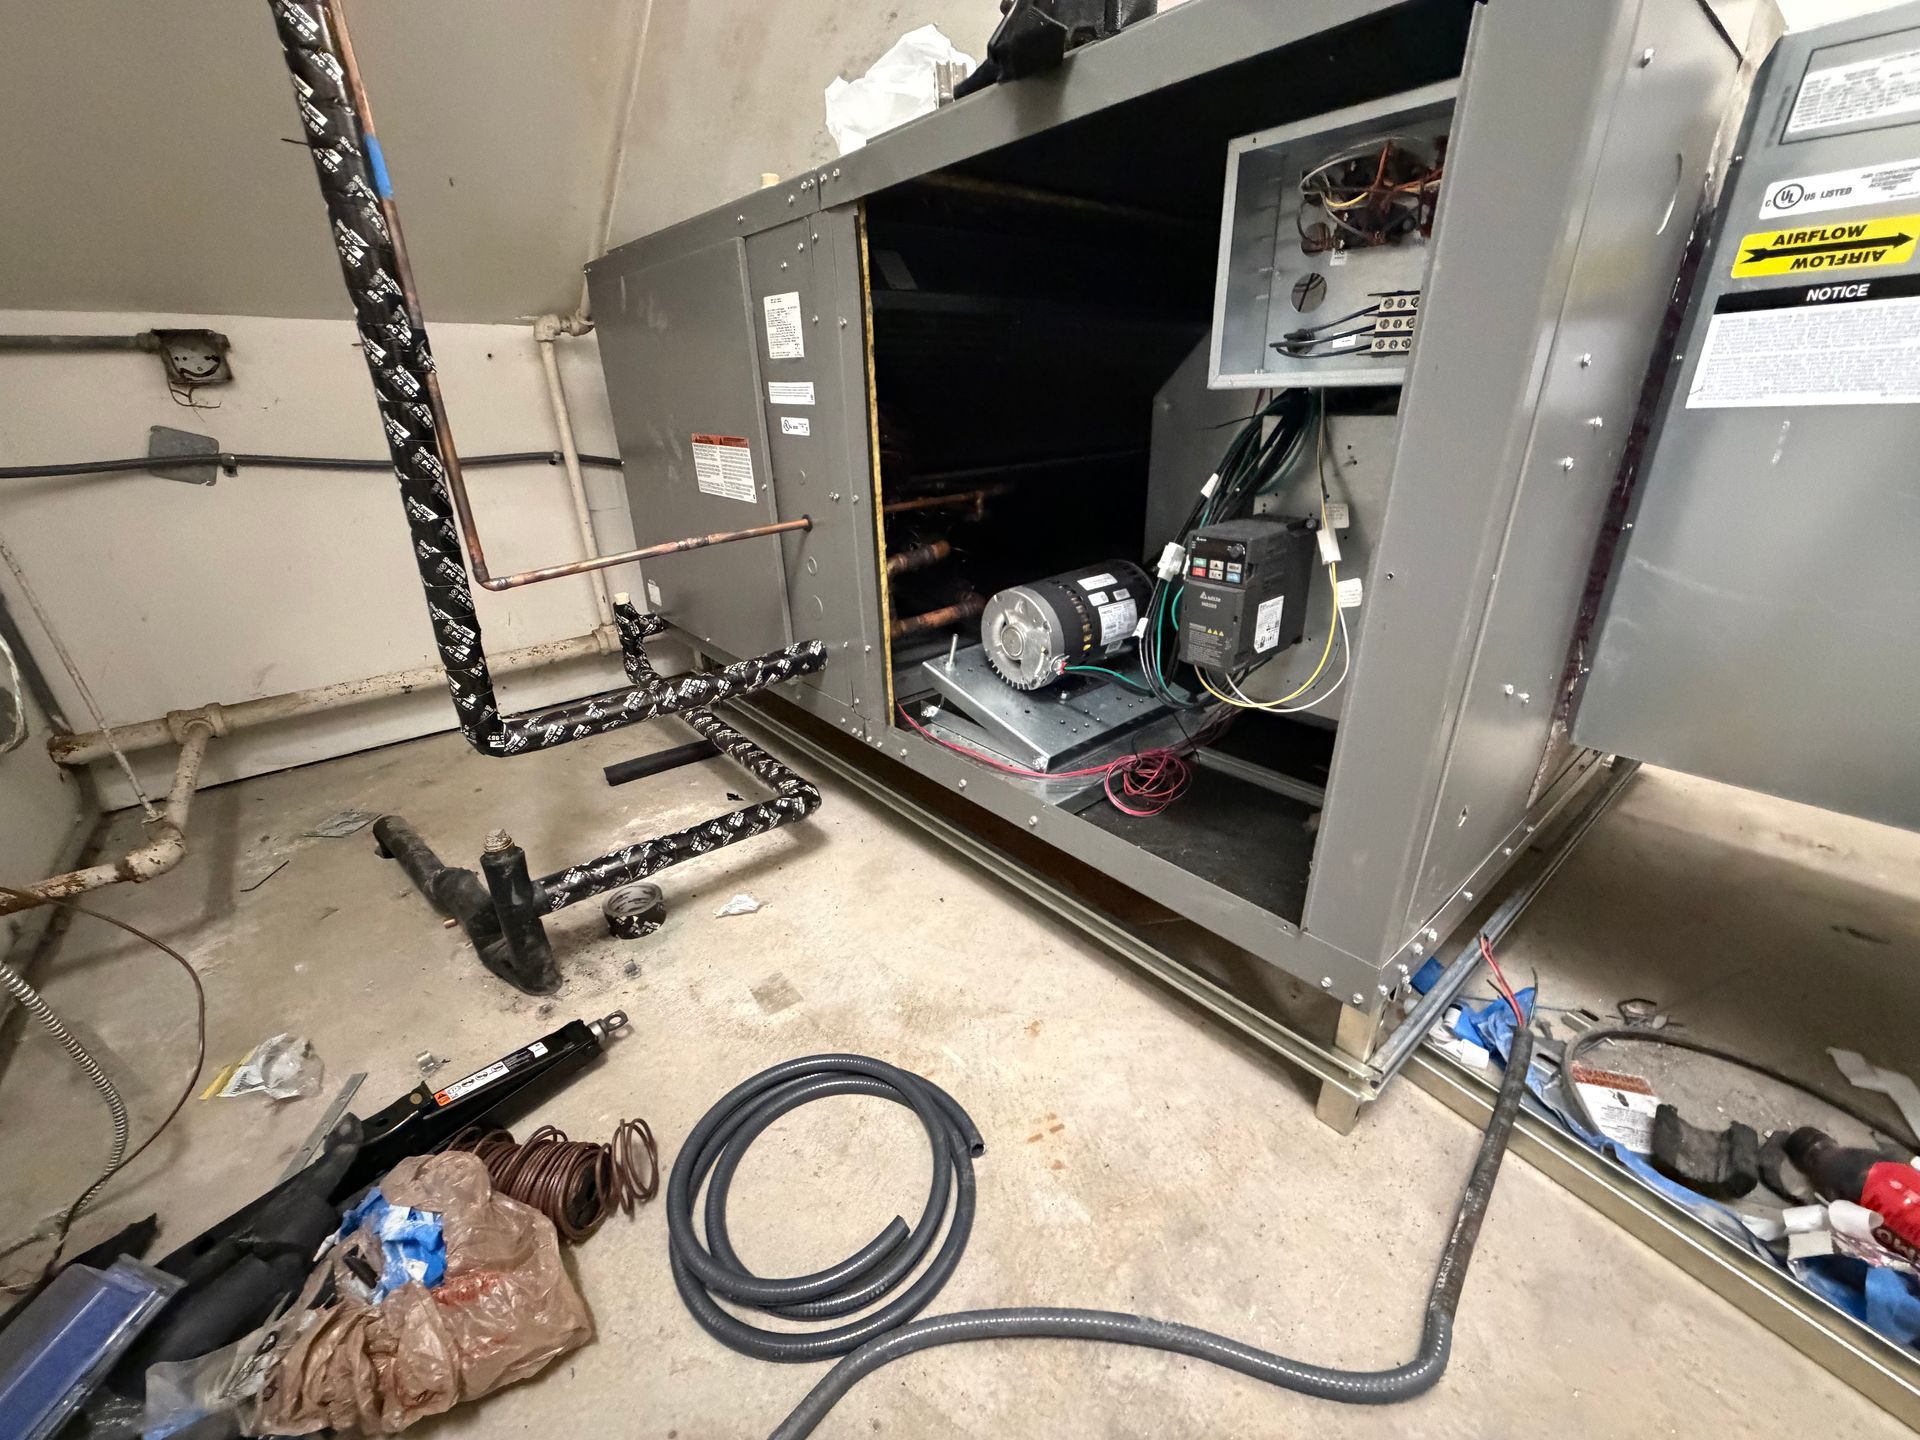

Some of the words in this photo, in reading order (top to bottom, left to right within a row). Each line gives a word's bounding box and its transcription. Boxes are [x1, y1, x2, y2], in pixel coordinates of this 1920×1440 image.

[283, 11, 296, 24] PC
[297, 24, 316, 40] 857
[322, 158, 338, 173] 857
[1820, 187, 1852, 199] LISTED
[1772, 224, 1868, 246] AIRFLOW
[347, 254, 361, 267] 857
[1790, 249, 1888, 270] AIRFLOW
[367, 290, 383, 303] 857
[1806, 283, 1871, 302] NOTICE
[386, 324, 398, 334] PC
[392, 375, 404, 386] PC
[403, 385, 418, 398] 857
[412, 406, 423, 417] PC
[421, 459, 433, 470] PC
[411, 509, 421, 518] PC
[445, 569, 456, 578] PC
[457, 594, 467, 603] PC
[452, 630, 462, 639] PC
[461, 637, 475, 646] 857
[445, 645, 455, 654] PC
[454, 652, 468, 662] 857
[470, 667, 483, 677] 857
[462, 701, 475, 710] 857
